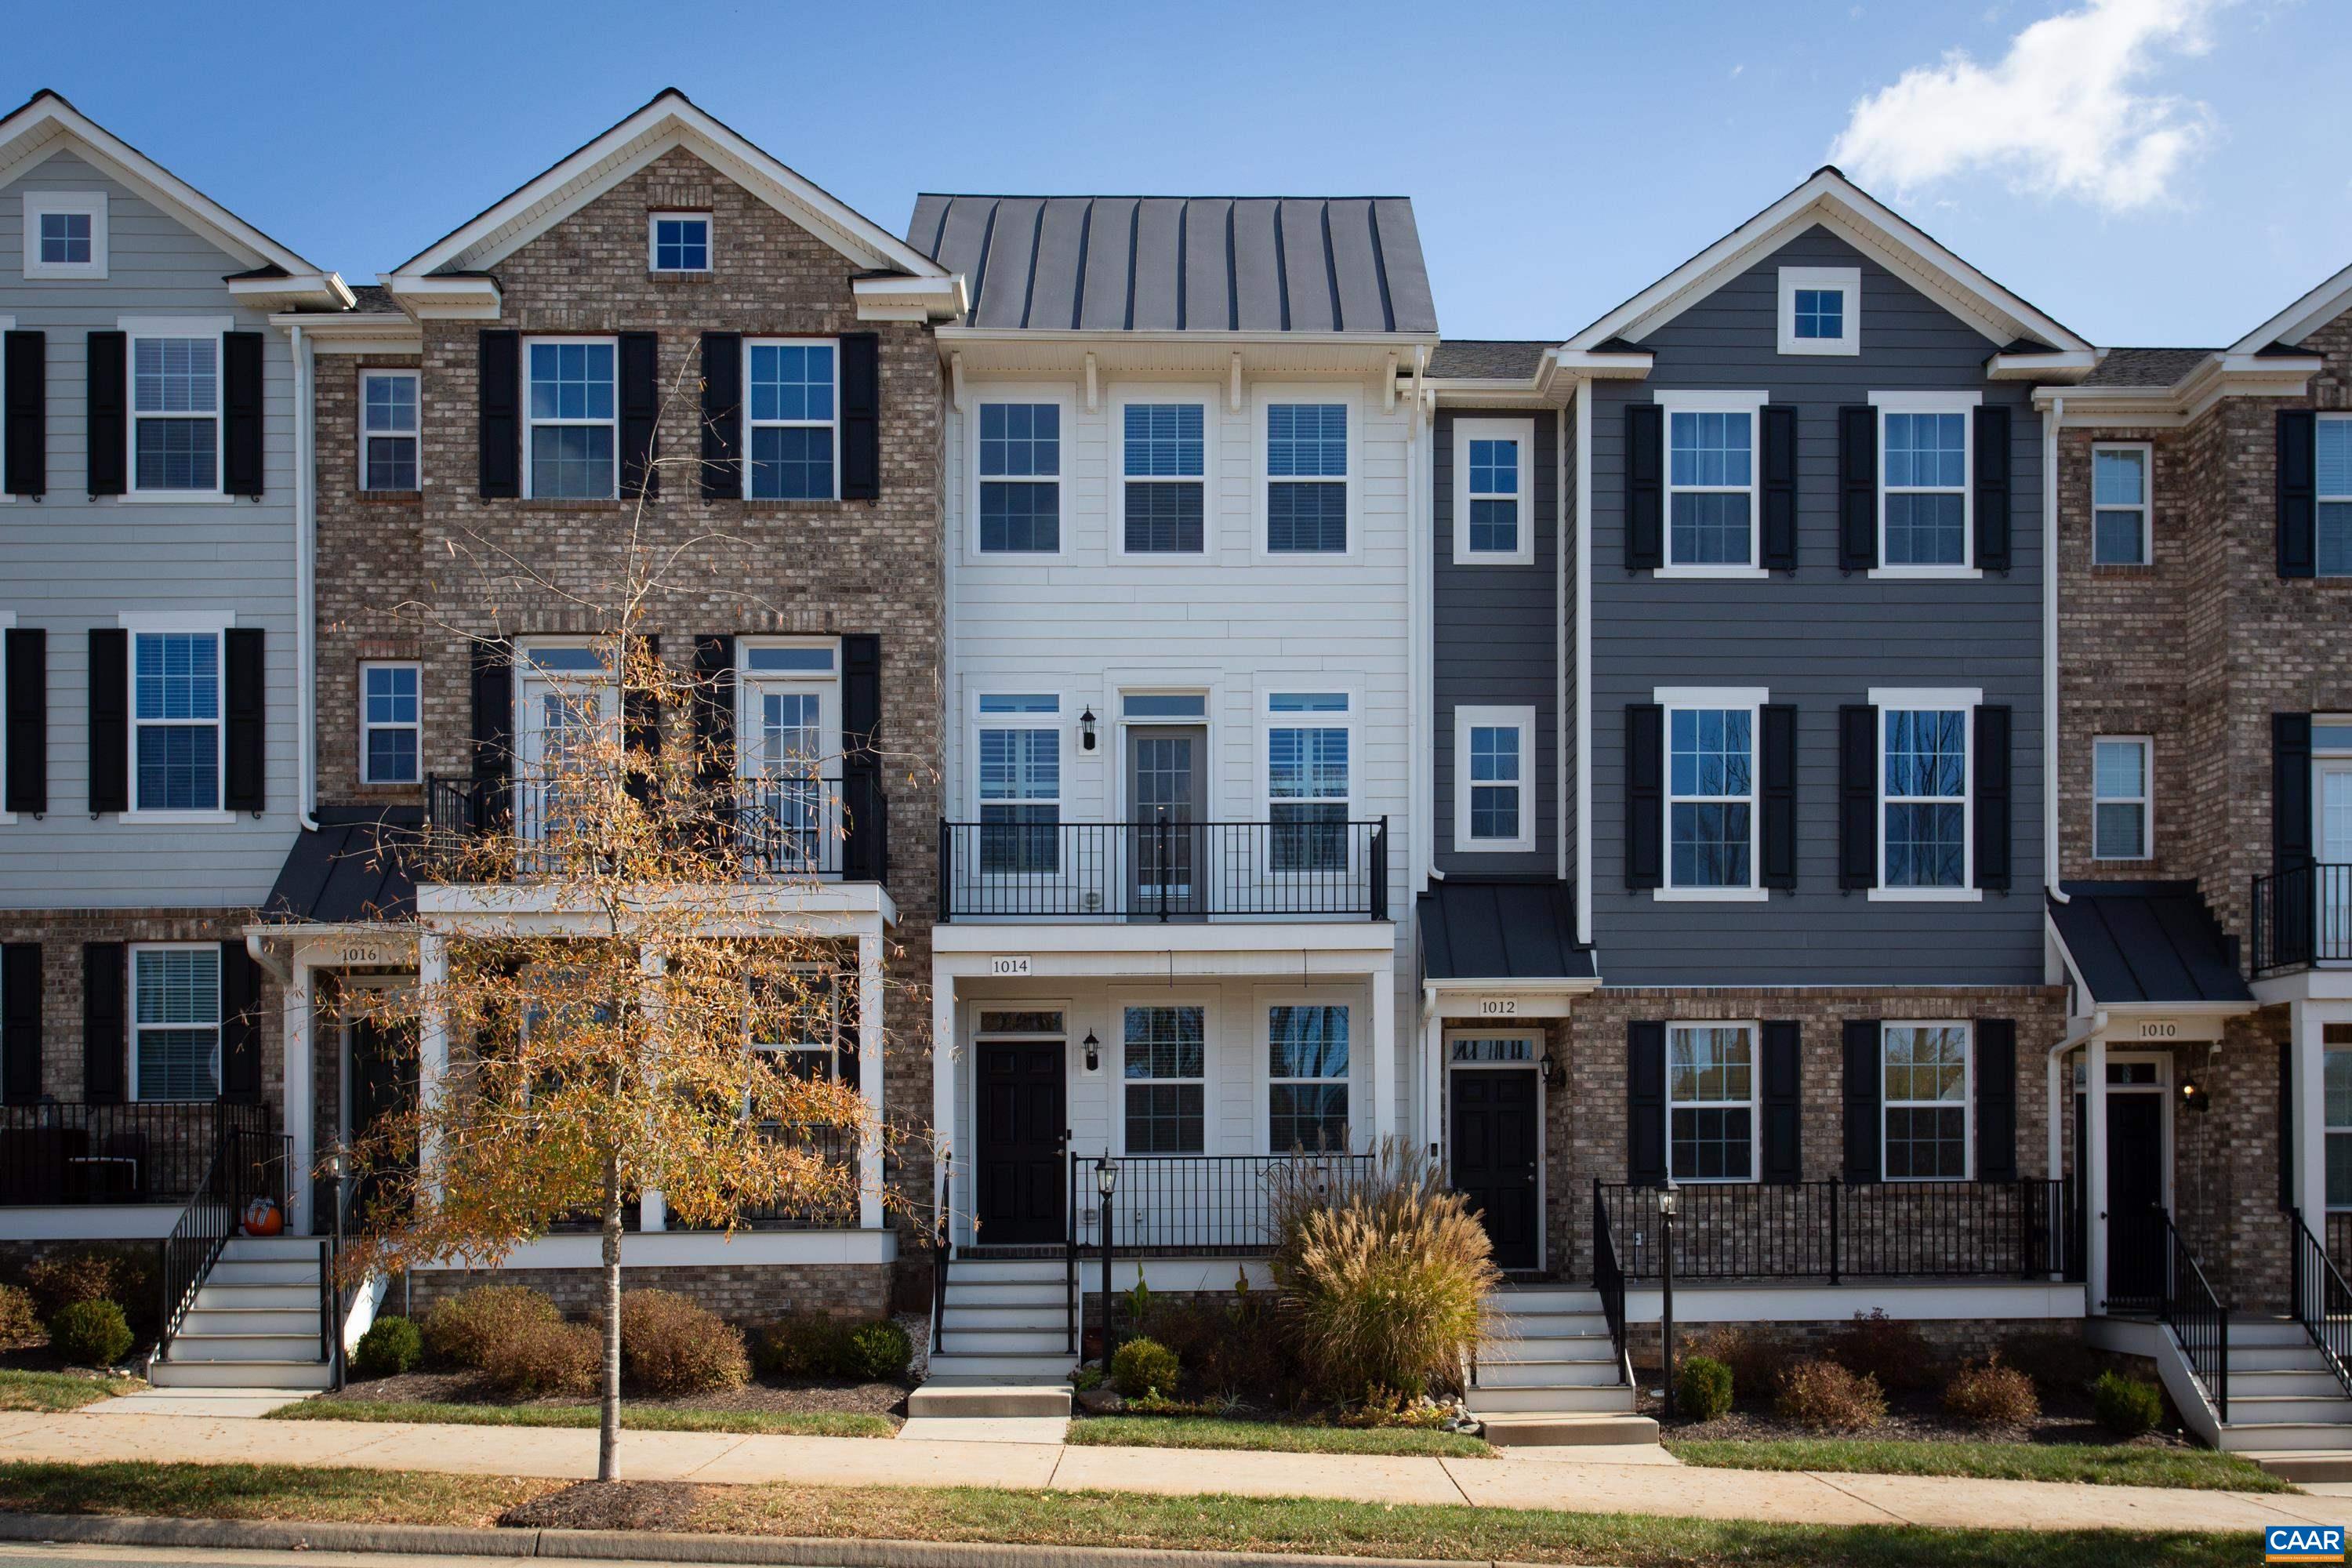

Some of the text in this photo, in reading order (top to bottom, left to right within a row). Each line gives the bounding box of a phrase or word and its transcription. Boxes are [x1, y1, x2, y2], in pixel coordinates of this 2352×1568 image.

[343, 948, 376, 960] 1016
[994, 960, 1028, 973] 1014
[1483, 1001, 1515, 1013] 1012
[2142, 1024, 2176, 1036] 1010
